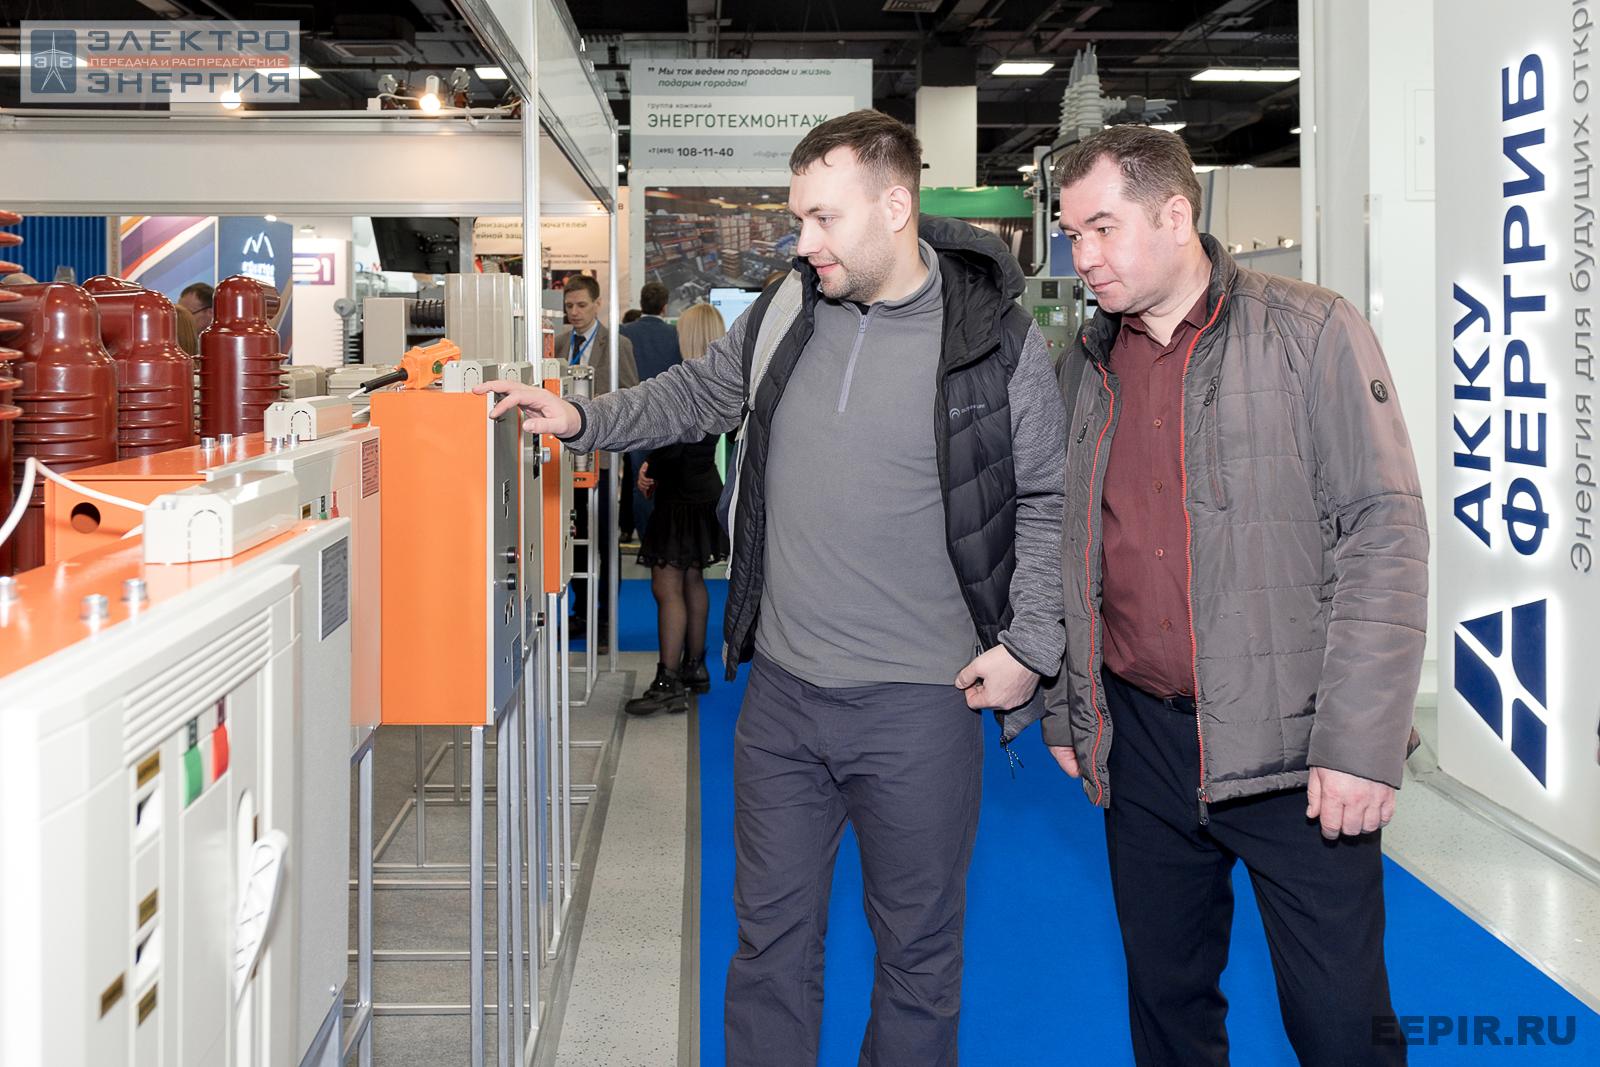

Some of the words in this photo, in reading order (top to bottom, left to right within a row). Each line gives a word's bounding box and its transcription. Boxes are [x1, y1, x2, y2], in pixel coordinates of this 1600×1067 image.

[658, 67, 675, 76] Мы
[677, 68, 693, 76] ток
[695, 67, 725, 76] ведем
[741, 67, 789, 77] проводам
[658, 79, 701, 88] подарим
[703, 79, 748, 88] городам!
[677, 147, 734, 157] 108-11-40
[1569, 113, 1595, 293] будущих
[1501, 53, 1549, 556] ФЕРТРИБ
[1574, 307, 1594, 381] для
[1453, 282, 1491, 549] АККУ
[1570, 394, 1596, 573] Энергия
